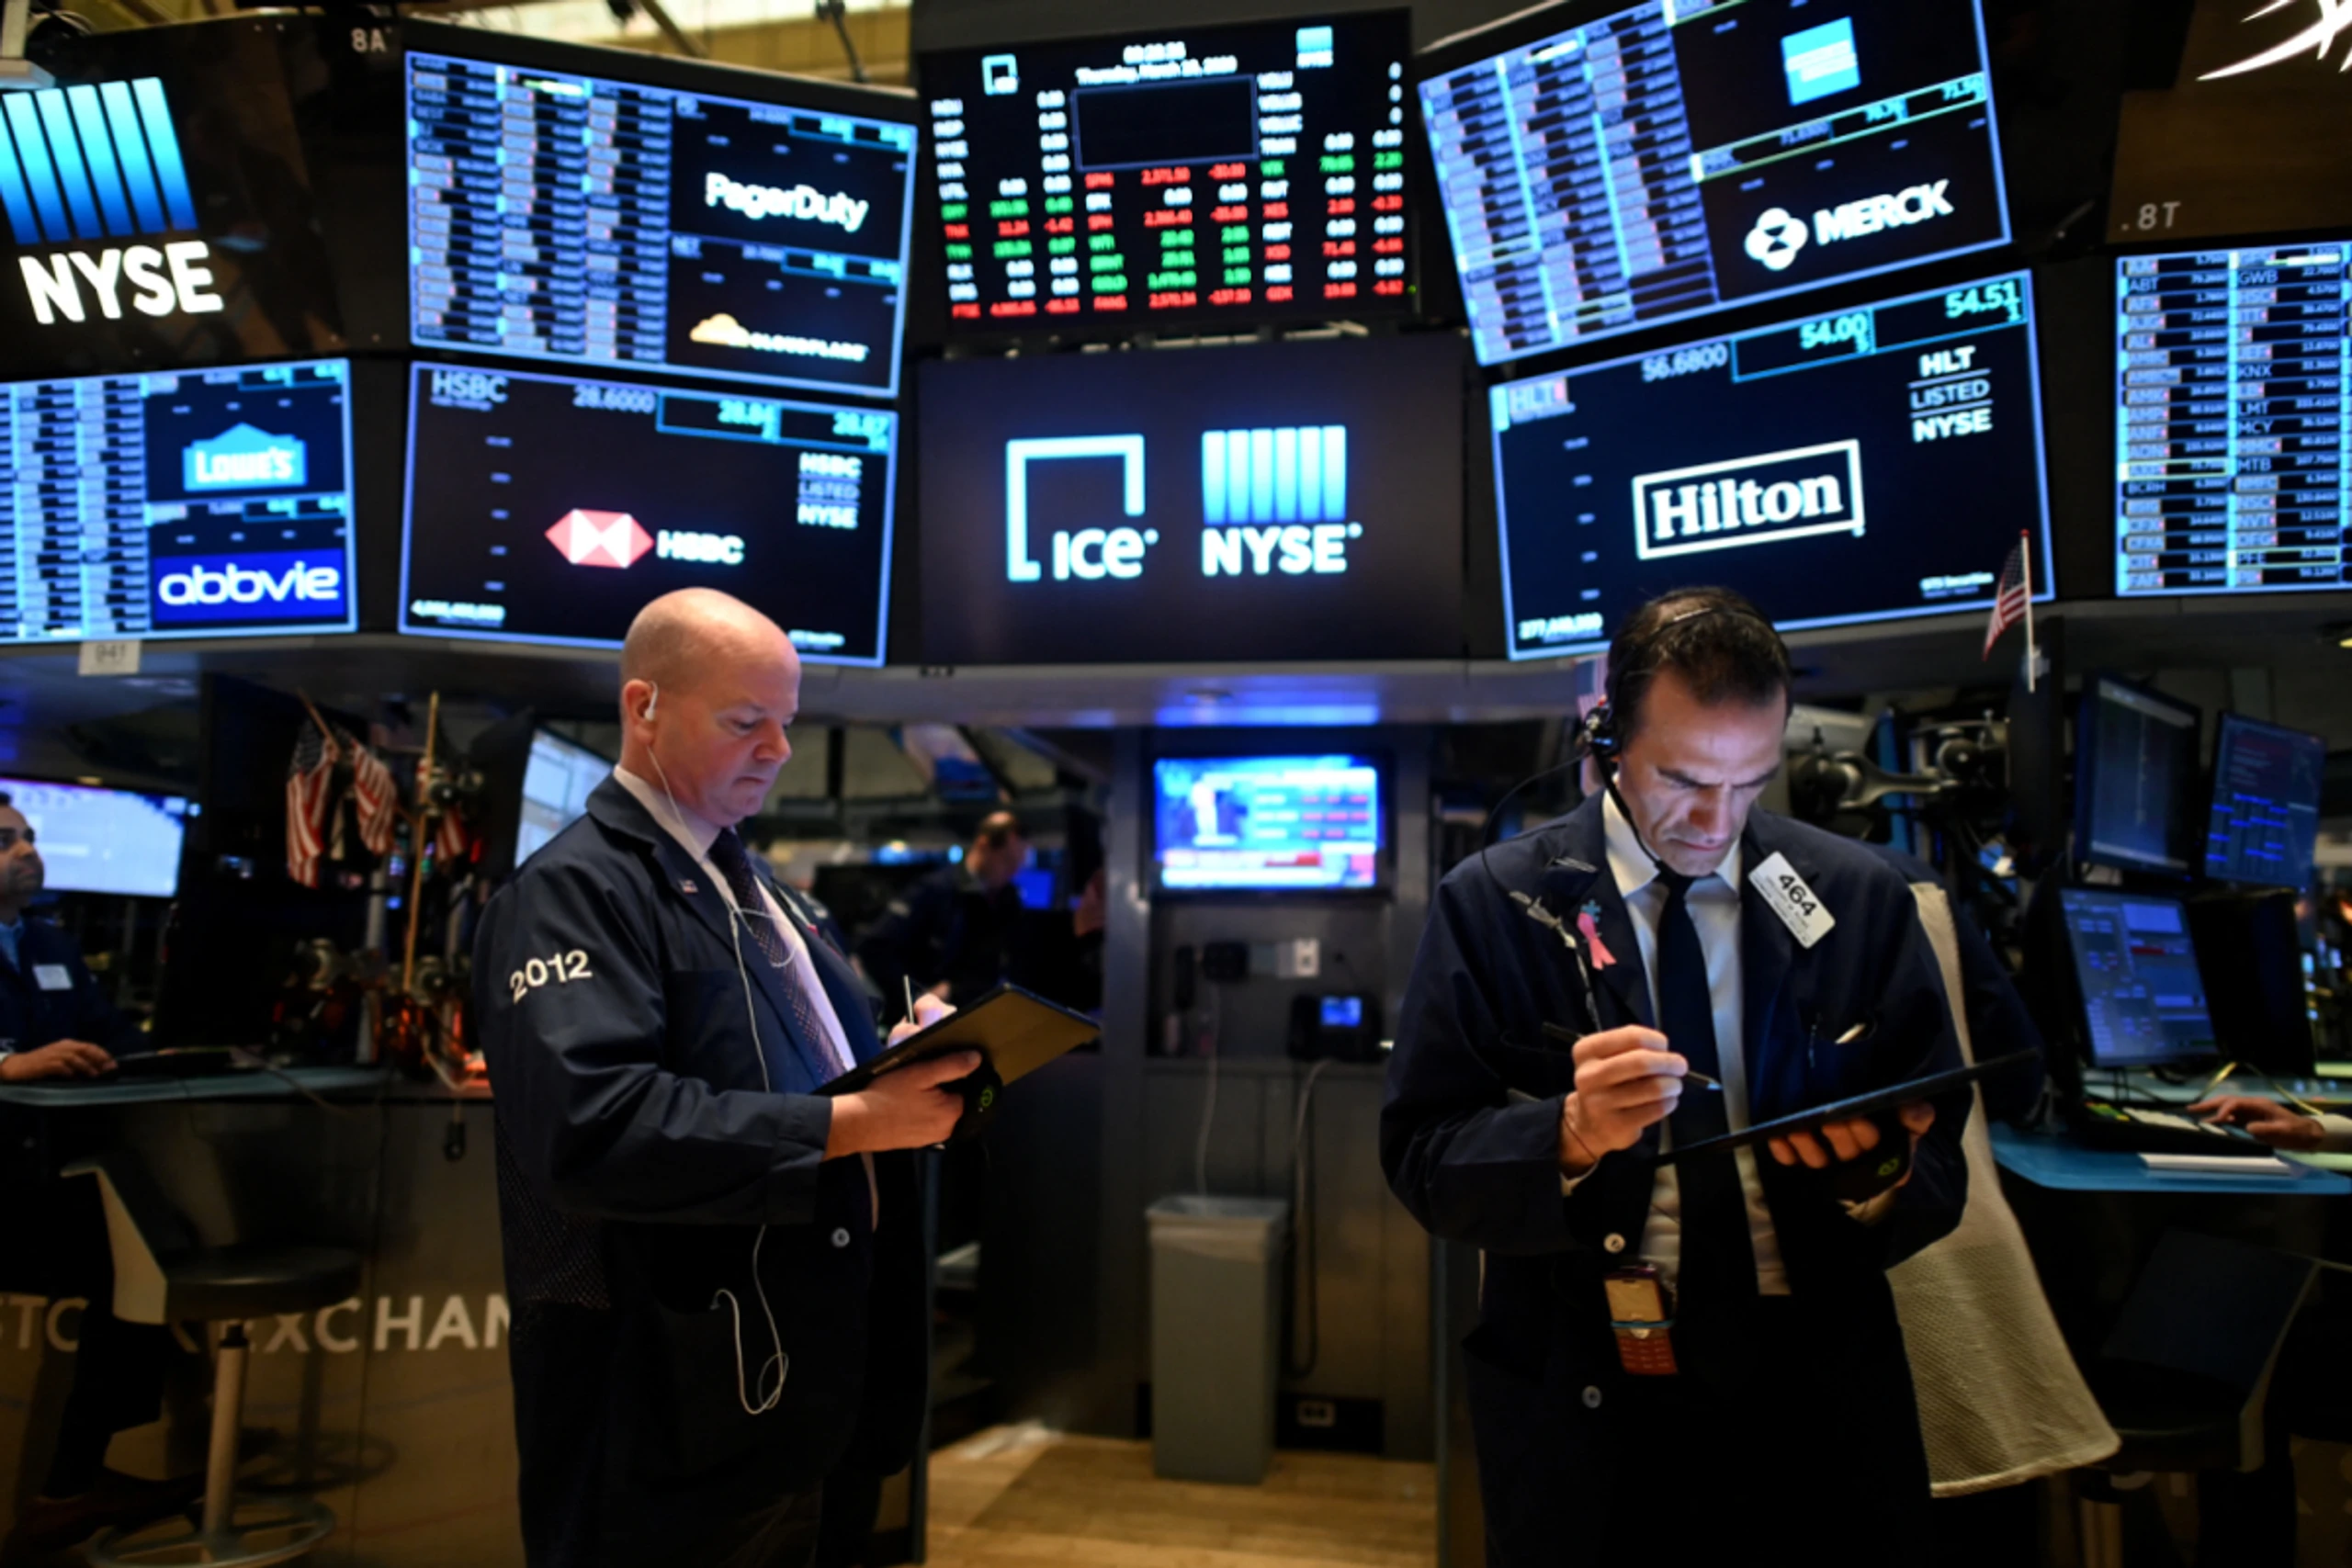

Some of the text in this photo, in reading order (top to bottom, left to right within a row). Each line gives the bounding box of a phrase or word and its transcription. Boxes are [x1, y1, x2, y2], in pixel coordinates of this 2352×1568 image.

[351, 28, 387, 52] 8A
[705, 172, 868, 232] PagerDuty
[1813, 178, 1954, 245] MERCK
[18, 241, 223, 324] NYSE
[2130, 278, 2158, 290] ABT
[2239, 270, 2278, 283] GWB
[1800, 313, 1867, 349] 54.00
[1945, 280, 2018, 318] 54.51
[1919, 345, 1975, 378] HLT
[2238, 366, 2271, 378] KNX
[432, 369, 508, 403] HSBC
[1910, 379, 1990, 410] LISTED
[1913, 408, 1992, 442] NYSE
[2238, 402, 2270, 414] LMT
[2238, 422, 2272, 434] MCY
[2238, 458, 2270, 471] MTB
[1652, 473, 1844, 539] Hilton
[657, 529, 744, 565] HSBC
[1202, 524, 1348, 577] NYSE
[2238, 552, 2266, 564] PFE
[158, 560, 341, 605] abbvie
[1779, 874, 1817, 916] 464
[509, 949, 593, 1004] 2012
[219, 1293, 511, 1353] XCHAN
